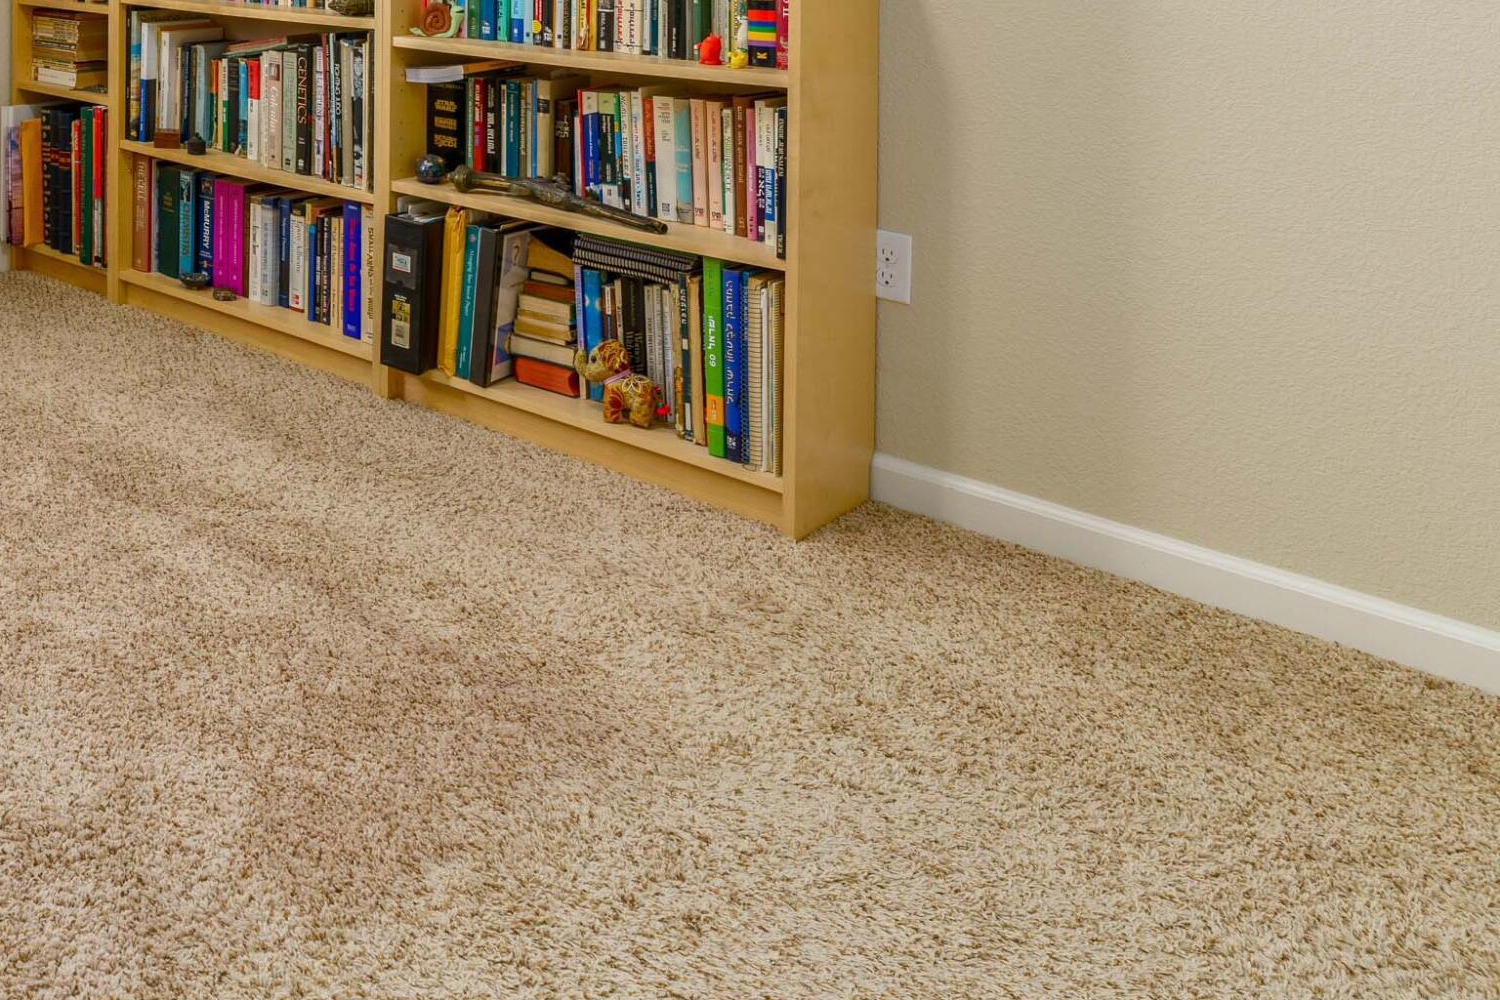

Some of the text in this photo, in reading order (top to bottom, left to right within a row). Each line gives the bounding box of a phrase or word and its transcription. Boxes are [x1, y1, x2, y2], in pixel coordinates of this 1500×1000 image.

[269, 86, 279, 133] Calculus
[297, 56, 308, 125] GENETICS
[137, 160, 147, 201] THE CELL
[707, 315, 717, 367] ישראל 60
[725, 280, 736, 404] המאבק לביטחון ישראל
